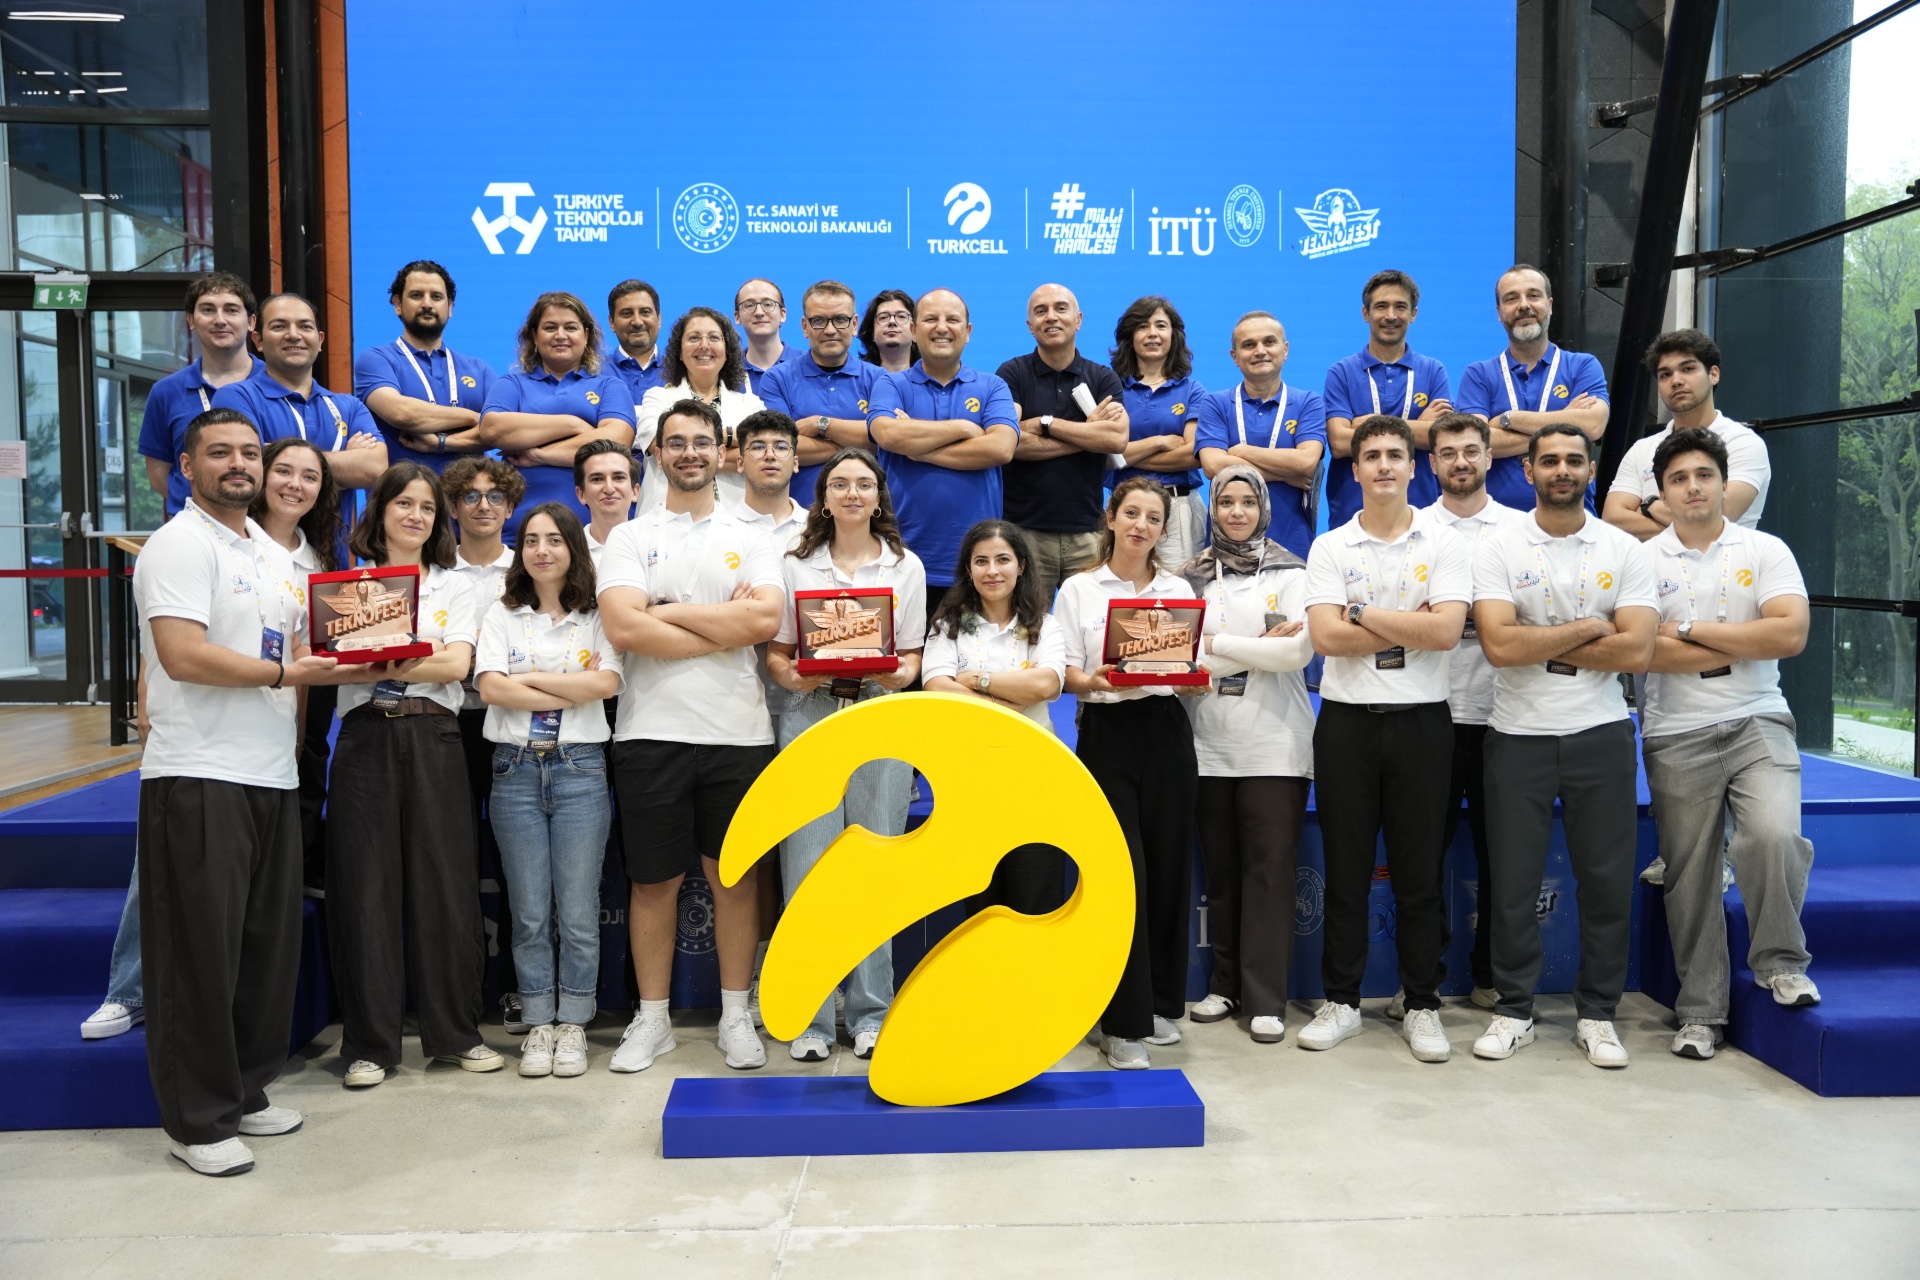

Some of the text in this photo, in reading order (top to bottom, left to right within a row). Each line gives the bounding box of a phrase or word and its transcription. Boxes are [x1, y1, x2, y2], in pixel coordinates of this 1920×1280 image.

[746, 203, 838, 217] T.C. SANAYİ VE
[553, 227, 608, 242] TAKIMI
[746, 219, 892, 233] TEKNOLOJİ BAKANLIĞI
[1148, 206, 1217, 256] İTÜ
[1299, 219, 1381, 256] TEKNOFEST
[927, 239, 1009, 254] TURKCELL
[325, 596, 410, 640] TEKNOFEST
[805, 615, 883, 649] TEKNOFEST
[1118, 627, 1194, 658] TEKNOFEST
